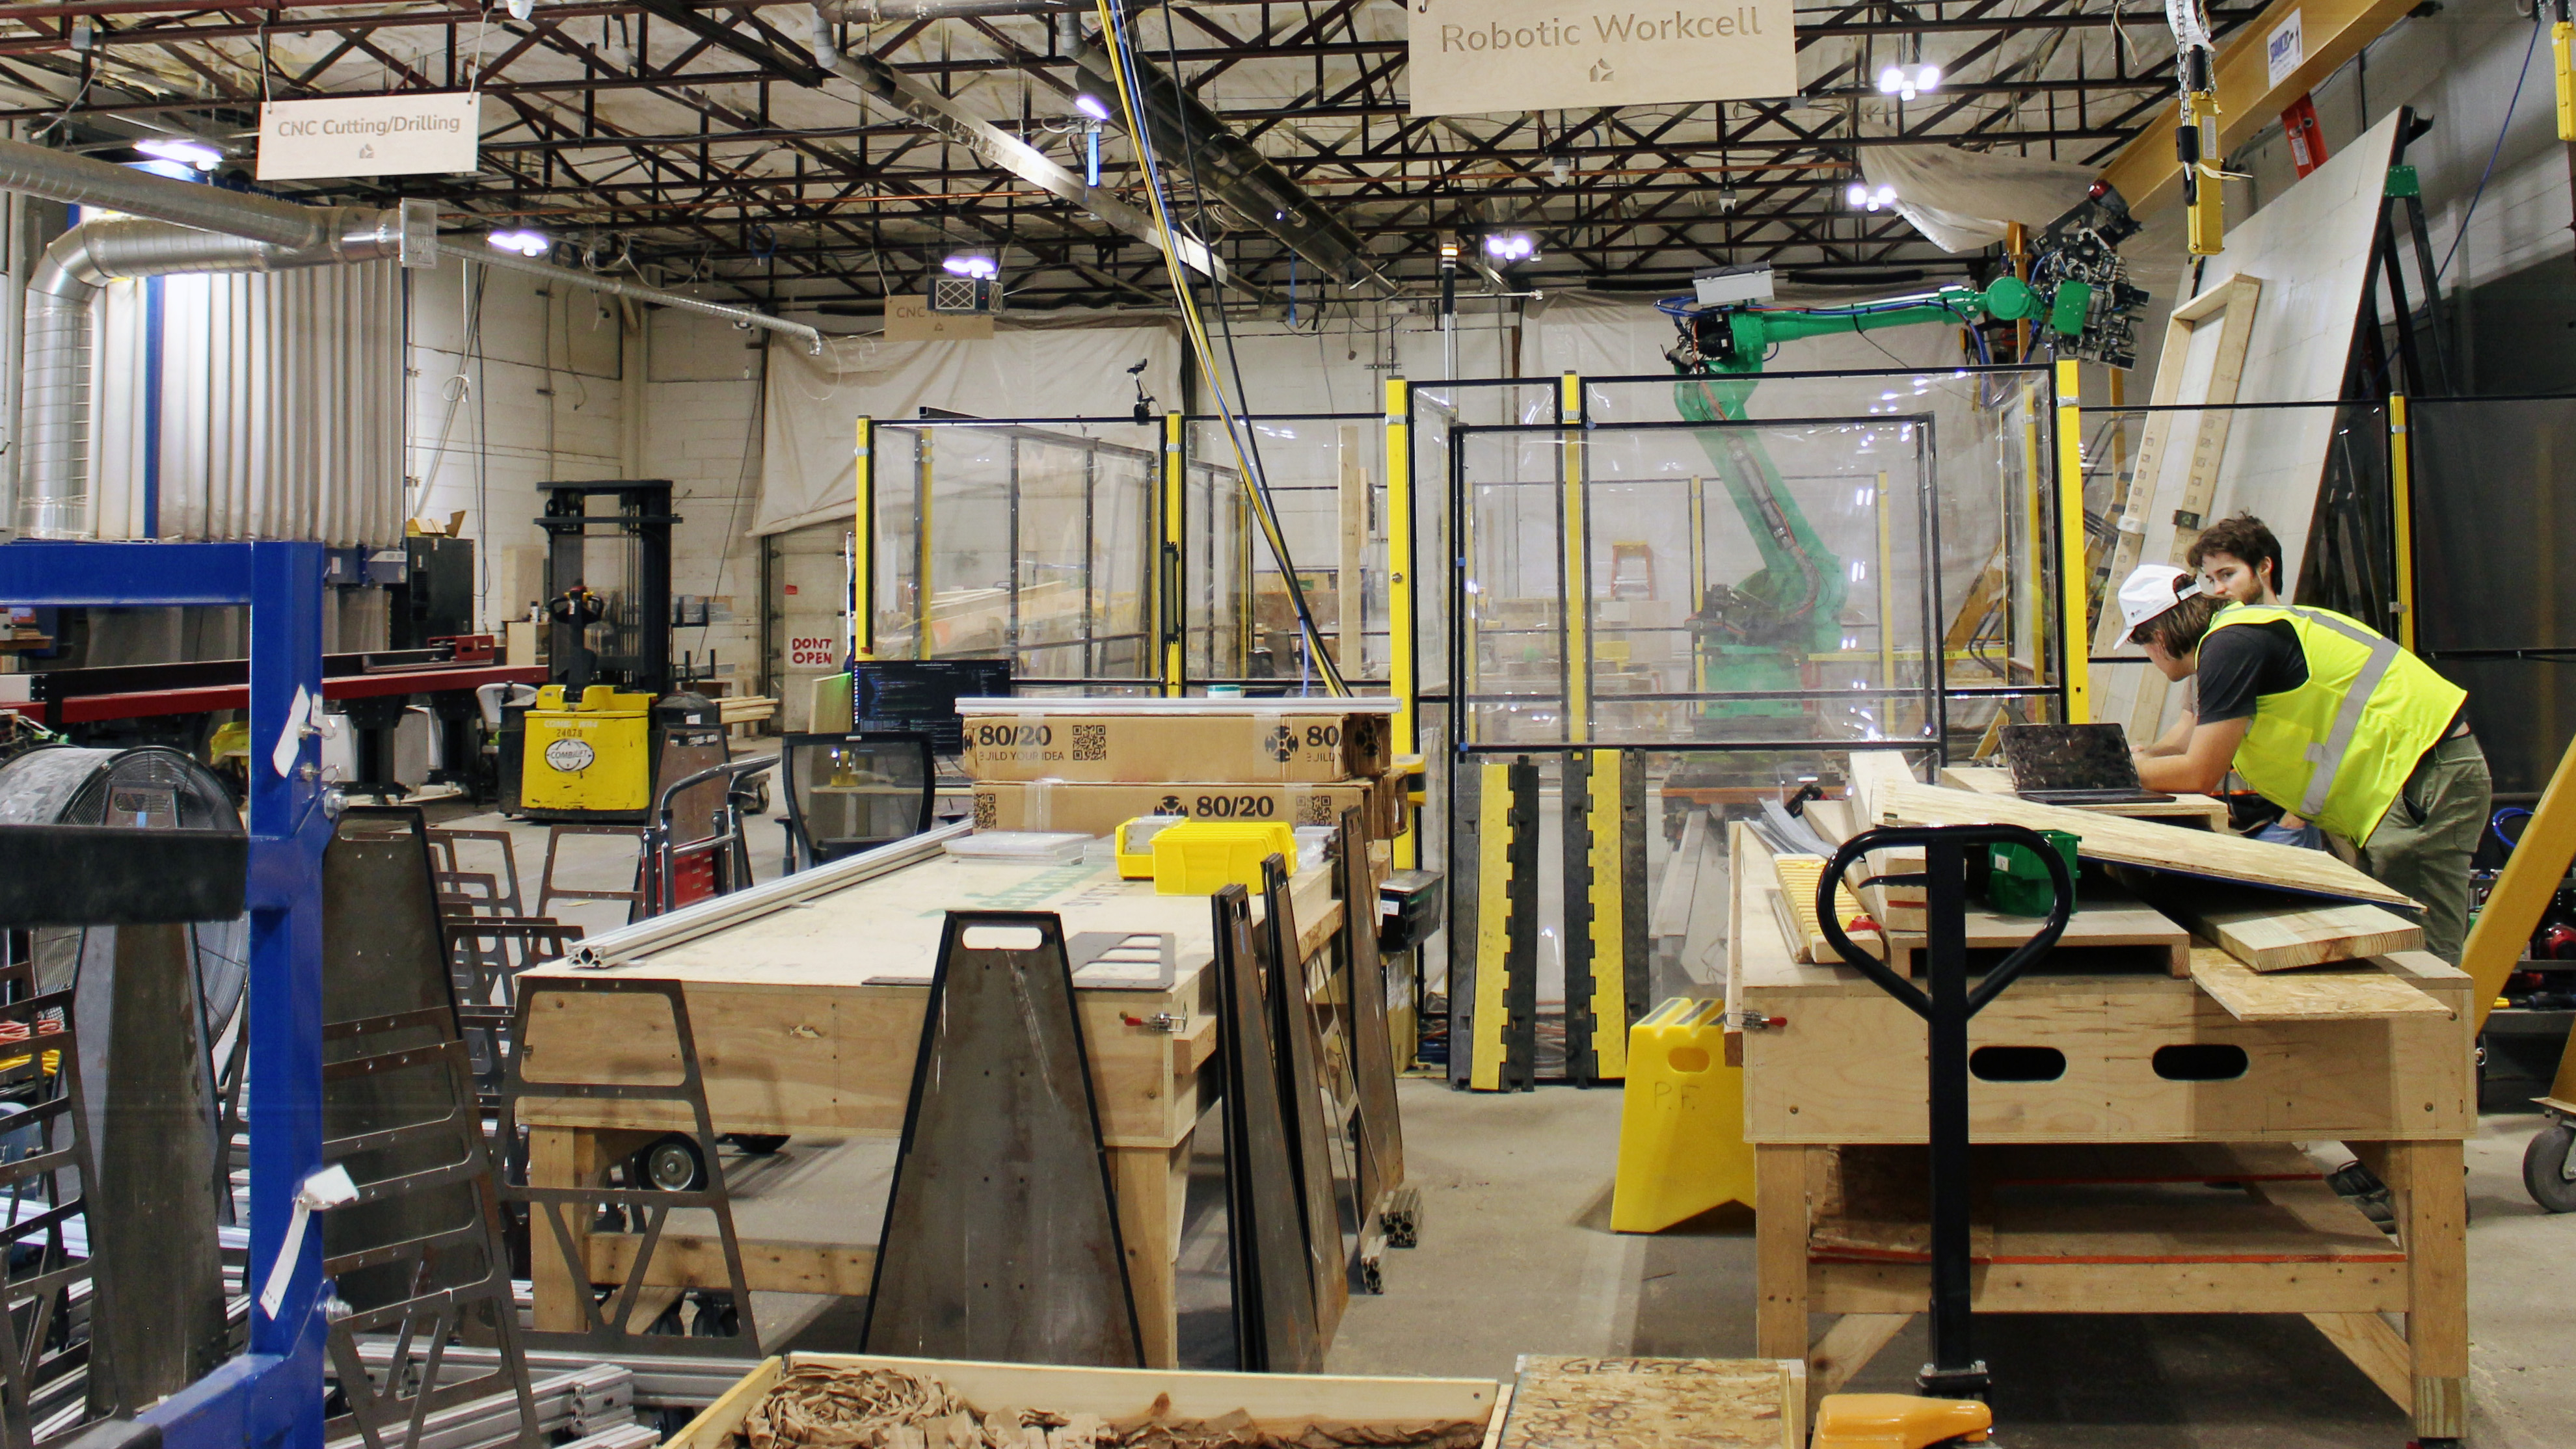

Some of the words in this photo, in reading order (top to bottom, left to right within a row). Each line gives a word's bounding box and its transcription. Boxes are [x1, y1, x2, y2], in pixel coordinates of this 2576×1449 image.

[1442, 17, 1581, 53] Robotic
[1592, 6, 1763, 44] Workcell
[278, 121, 317, 137] CNC
[322, 114, 461, 137] Cutting/Drilling
[896, 306, 926, 318] CNC
[792, 637, 833, 650] DONT
[792, 652, 832, 664] OPEN
[979, 725, 1052, 746] 80/20
[1010, 751, 1039, 761] YOUR
[1041, 751, 1064, 761] IDEA
[1196, 795, 1274, 818] 80/20
